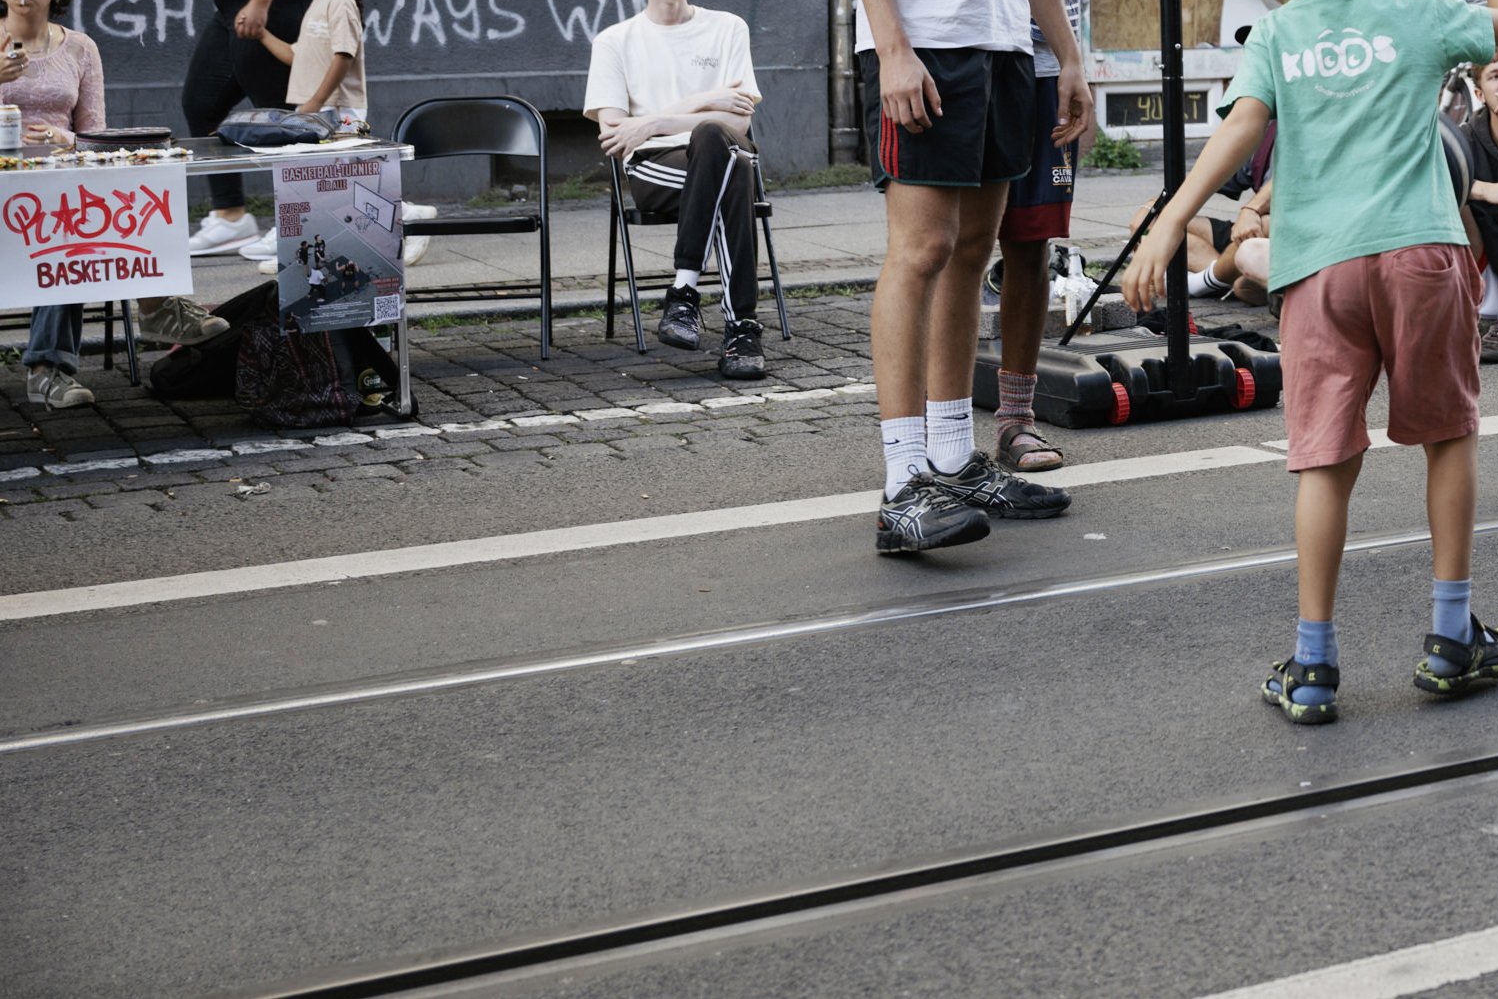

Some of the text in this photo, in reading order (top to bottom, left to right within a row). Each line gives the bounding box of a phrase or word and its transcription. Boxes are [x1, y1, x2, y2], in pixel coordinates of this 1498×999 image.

[282, 162, 381, 182] BASKETBALL-TURNIER
[317, 179, 348, 192] FÜR ALLE
[280, 224, 303, 238] RABET
[36, 256, 164, 289] BASKETBALL
